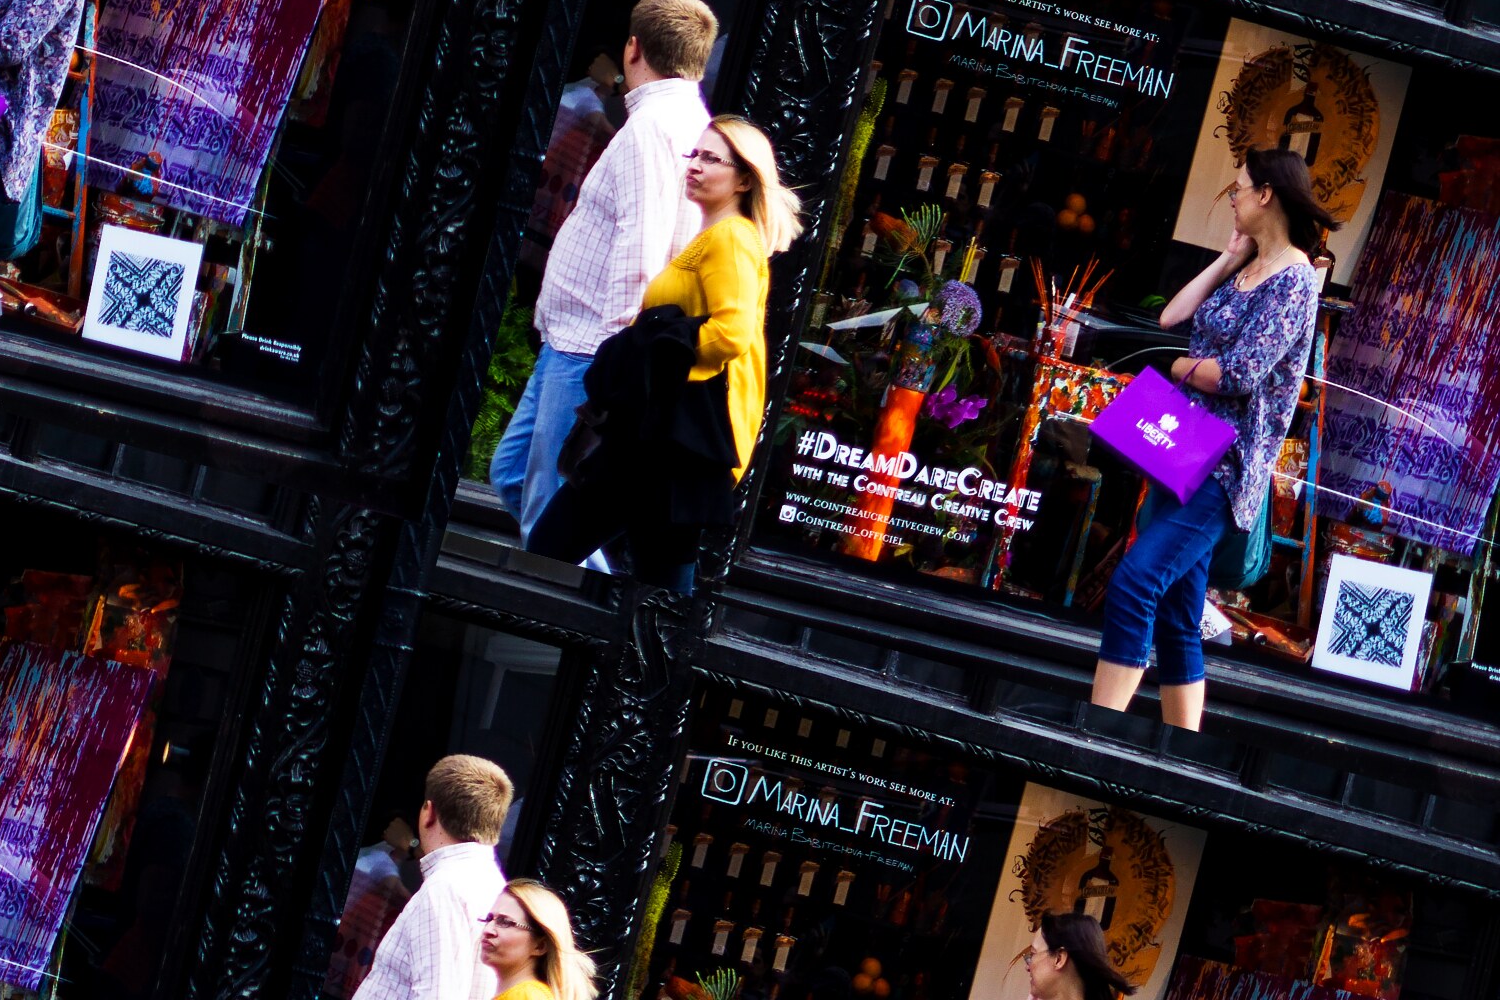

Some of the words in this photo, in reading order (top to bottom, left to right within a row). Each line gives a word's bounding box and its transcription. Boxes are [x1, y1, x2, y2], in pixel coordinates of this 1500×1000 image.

[242, 333, 257, 341] Please
[273, 340, 301, 352] Responsibly
[1136, 417, 1176, 448] LIBERTY
[1472, 662, 1487, 670] Please
